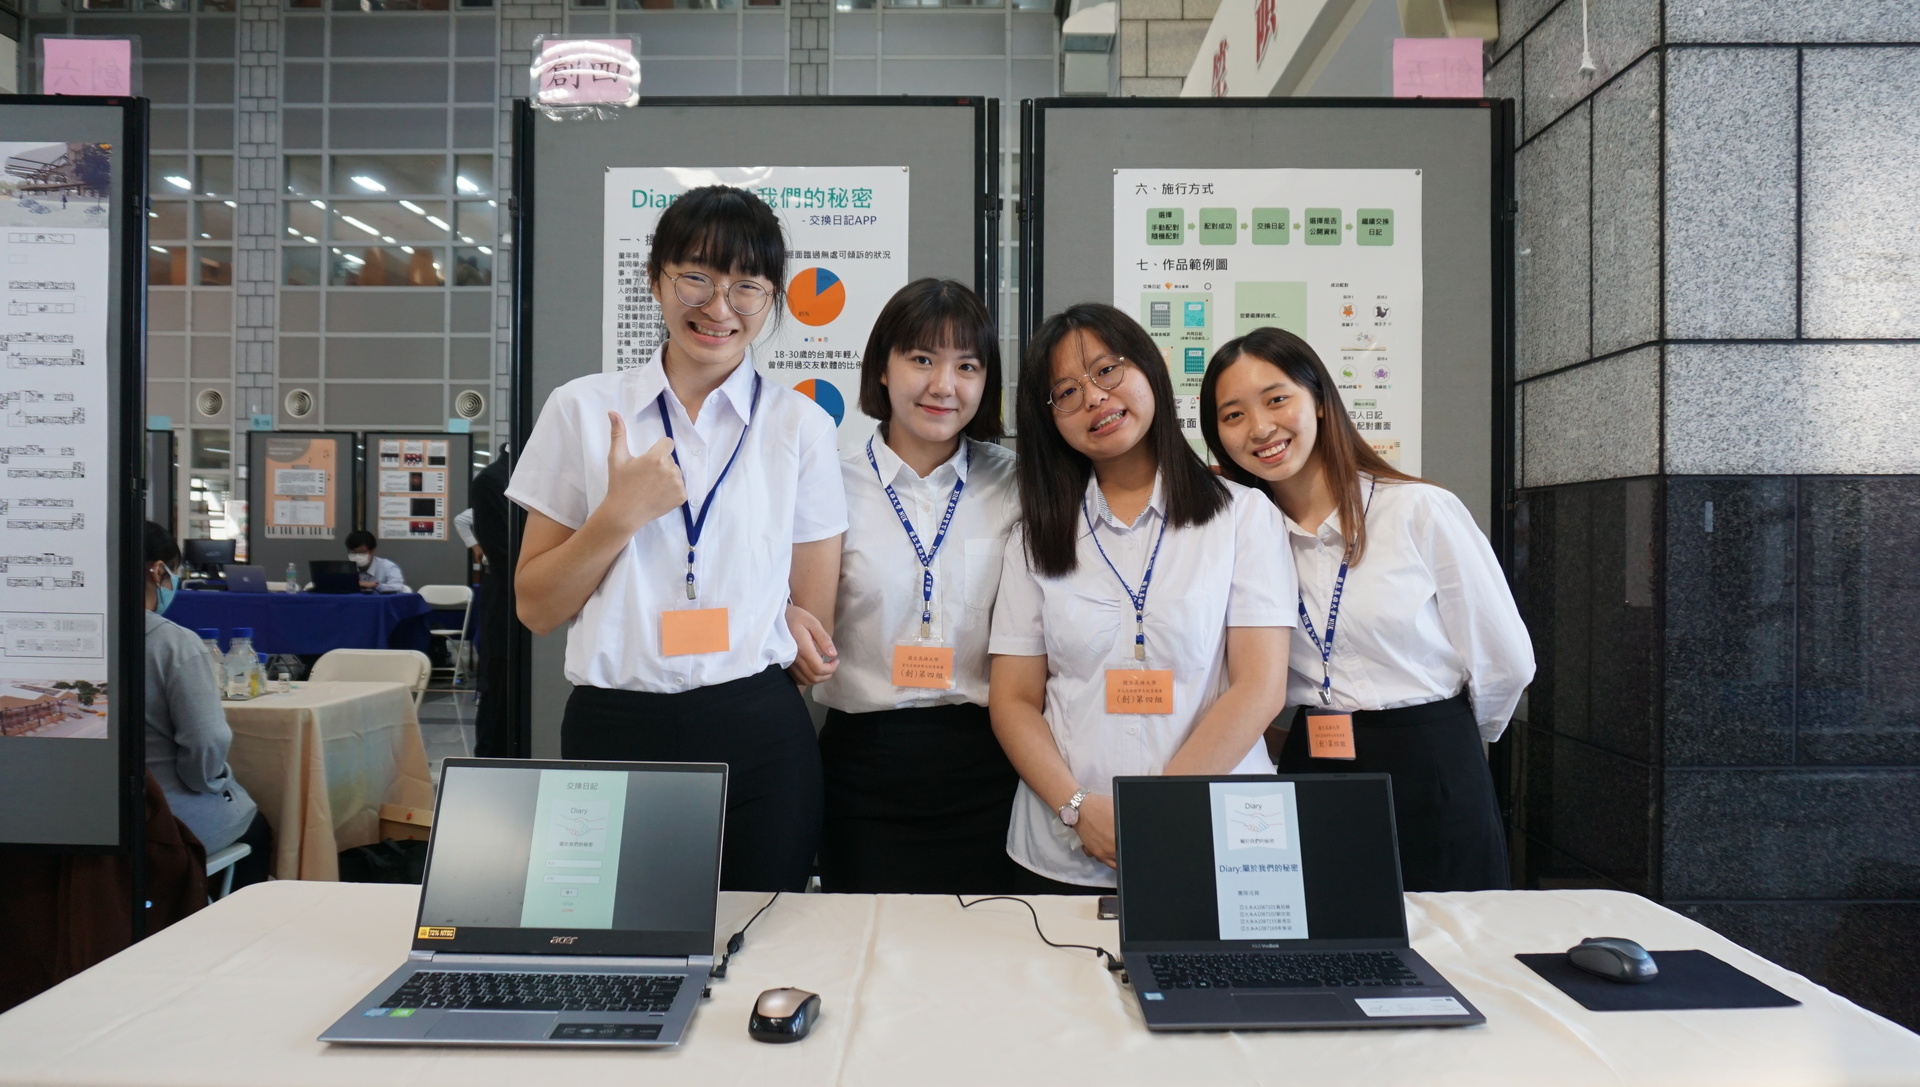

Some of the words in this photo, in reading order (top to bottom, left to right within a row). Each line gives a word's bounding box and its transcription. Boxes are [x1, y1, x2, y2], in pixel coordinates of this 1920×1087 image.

[1135, 183, 1214, 196] 六、施行方式
[1158, 211, 1172, 219] 選擇
[811, 215, 877, 227] 交換日記APP
[1309, 217, 1337, 225] 選擇是否
[1362, 218, 1389, 226] 繼續交換
[1151, 224, 1179, 232] 手動配對
[1204, 222, 1233, 230] 配對成功
[1257, 222, 1285, 230] 交換日記
[1151, 232, 1179, 240] 隨機配對
[1309, 228, 1337, 236] 公開資料
[1136, 258, 1228, 271] 七、作品範例圖
[774, 351, 860, 360] 18-30歲的台灣年輕人
[566, 782, 598, 791] 交換日記
[1244, 803, 1262, 811] Diary
[571, 807, 588, 816] Diary
[550, 936, 578, 945] acer
